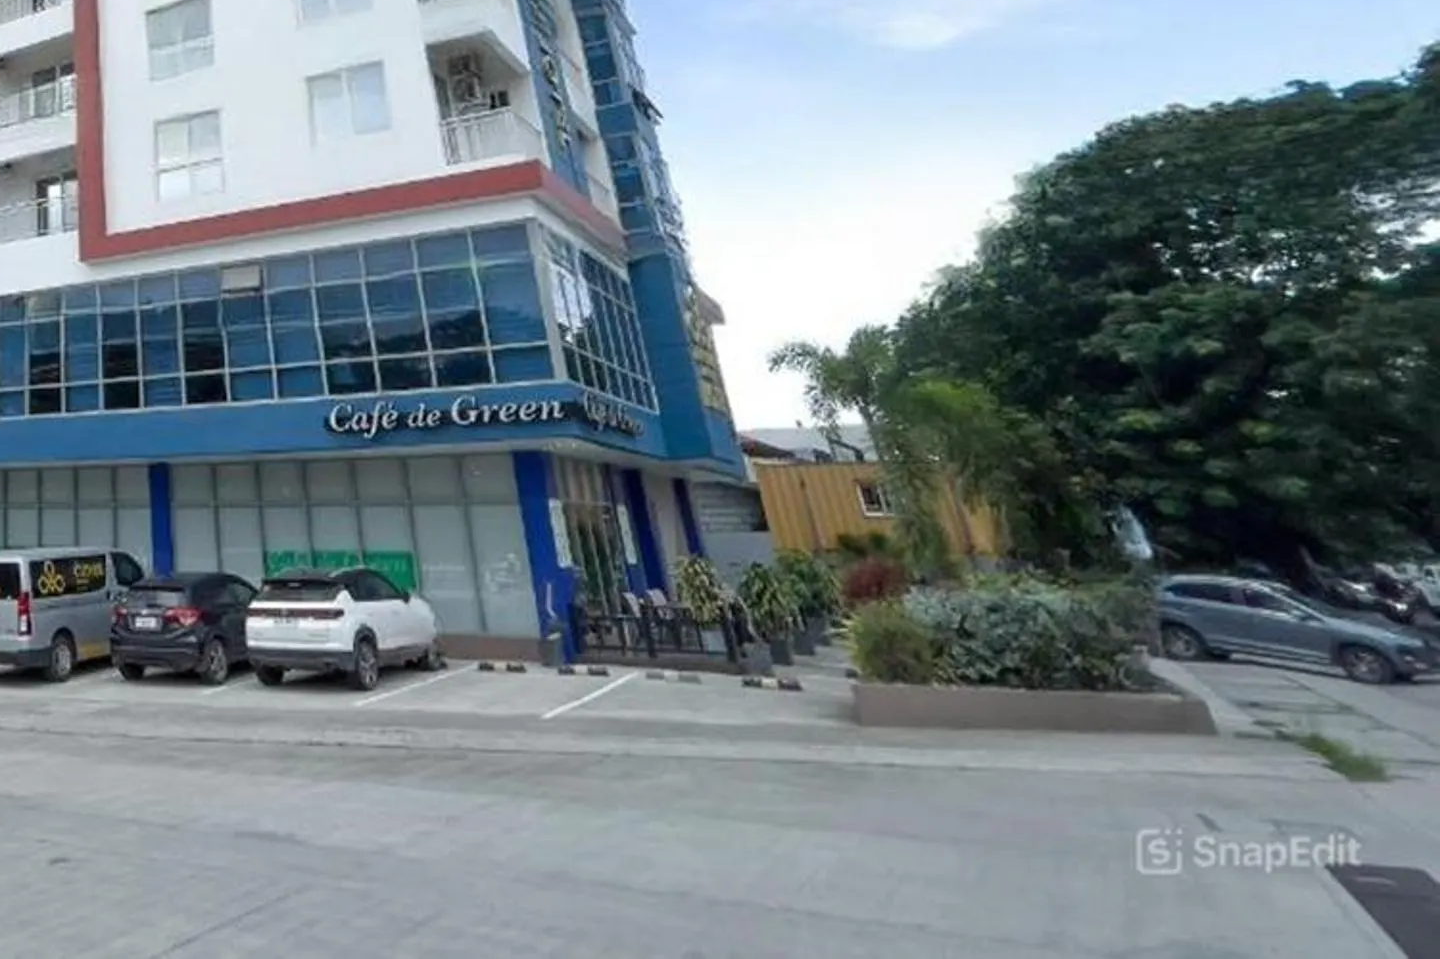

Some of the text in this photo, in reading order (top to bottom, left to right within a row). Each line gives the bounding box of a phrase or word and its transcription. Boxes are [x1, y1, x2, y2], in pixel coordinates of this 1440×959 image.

[329, 400, 398, 439] Café
[407, 403, 441, 428] de
[451, 394, 565, 426] Green
